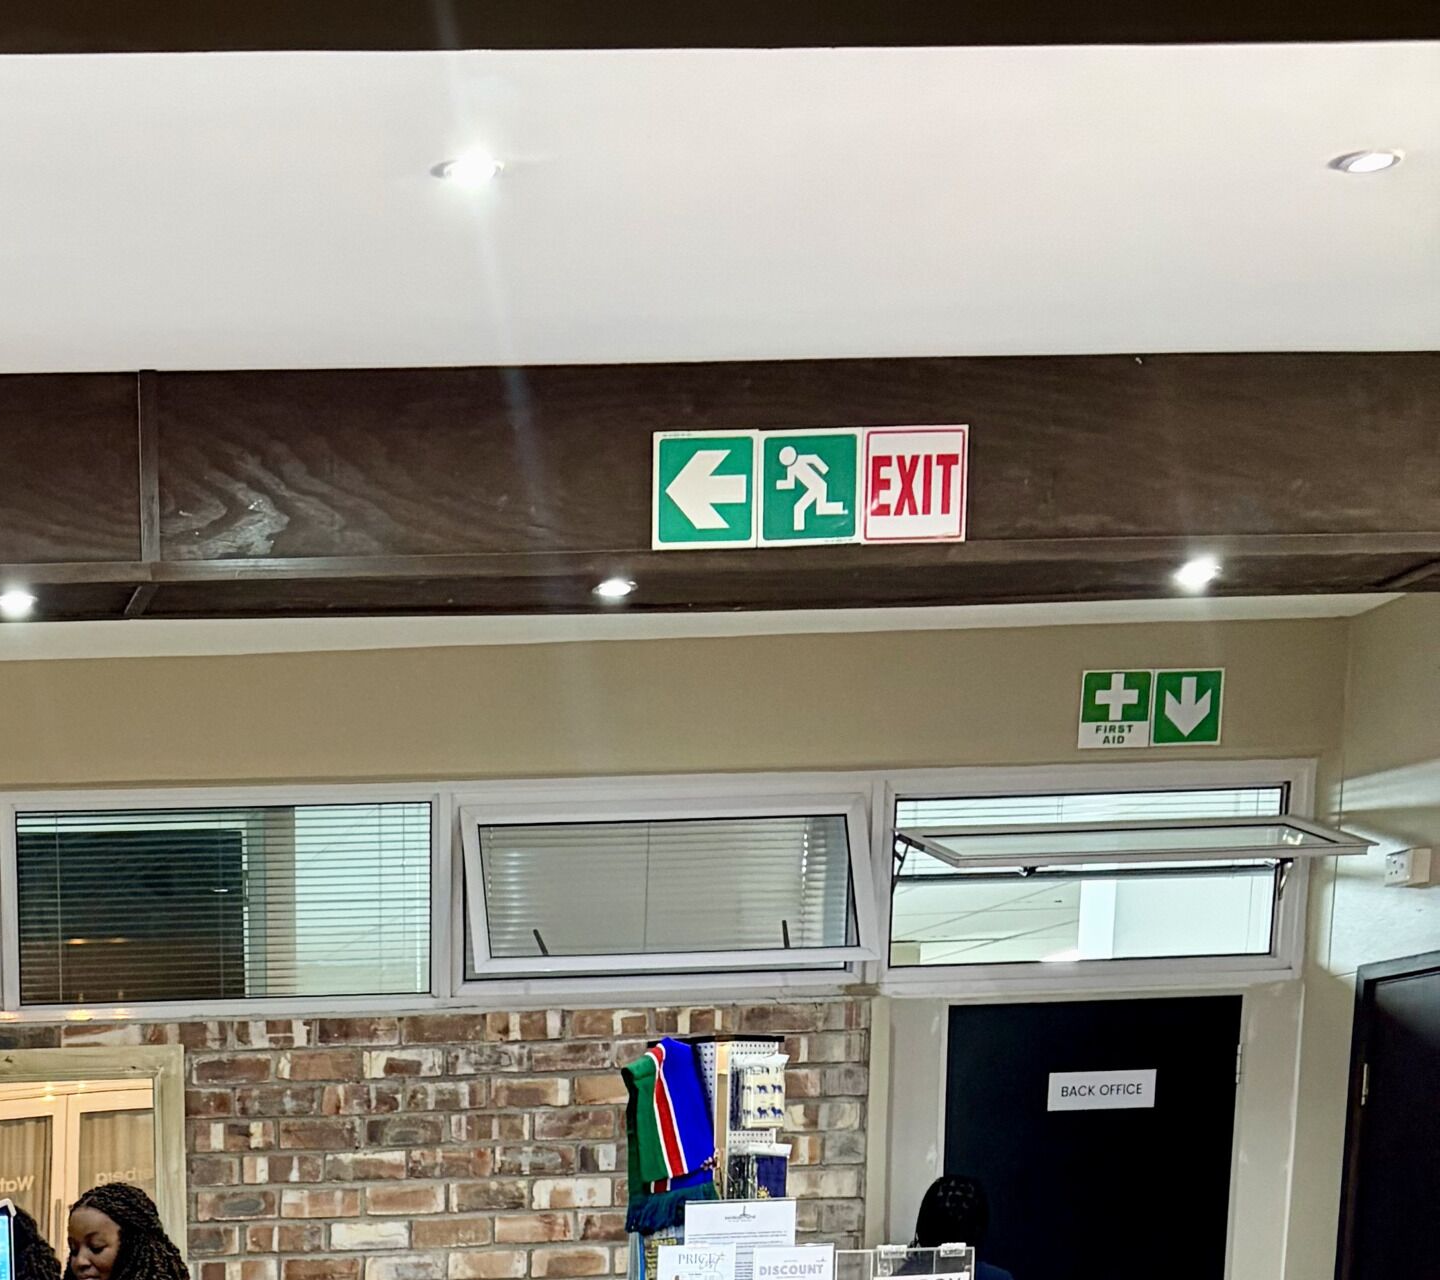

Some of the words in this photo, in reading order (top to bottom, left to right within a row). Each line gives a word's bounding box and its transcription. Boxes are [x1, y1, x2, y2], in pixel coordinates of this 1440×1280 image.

[870, 453, 959, 517] EXIT
[1095, 724, 1134, 734] FIRST
[1102, 735, 1125, 745] AID
[1061, 1085, 1096, 1098] BACK
[1099, 1083, 1143, 1096] OFFICE
[759, 1264, 824, 1276] DISCOUNT
